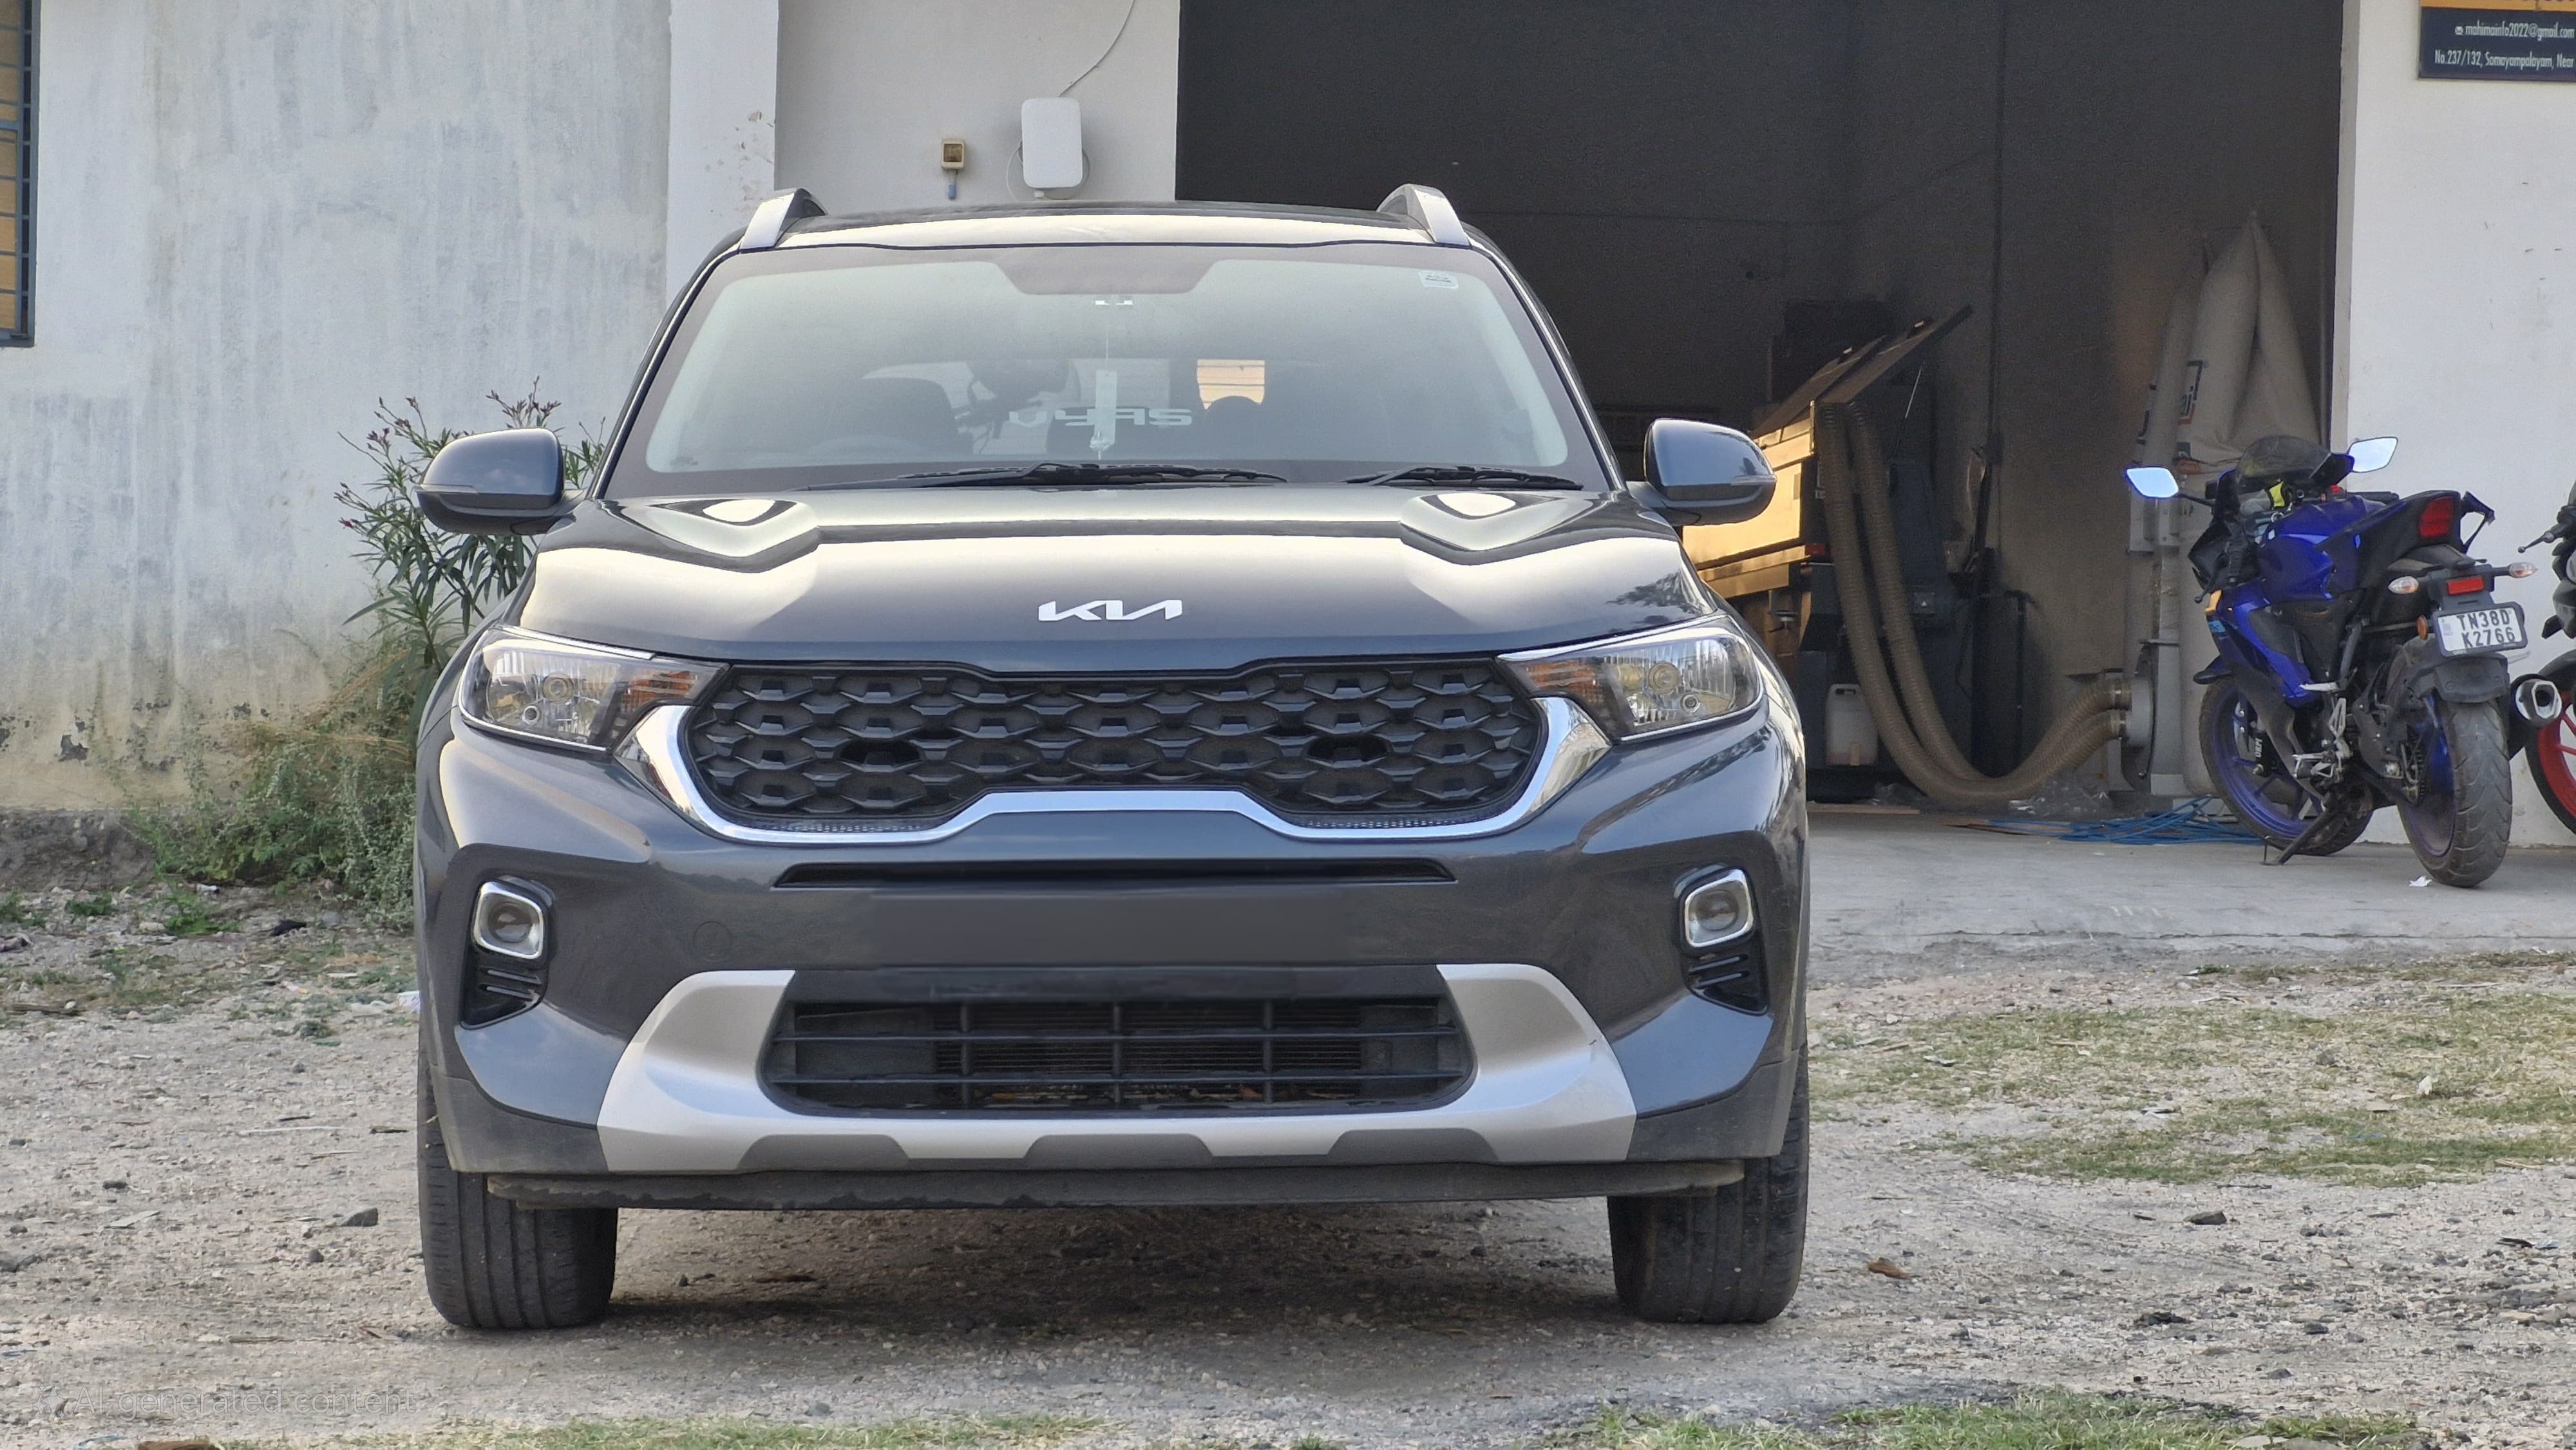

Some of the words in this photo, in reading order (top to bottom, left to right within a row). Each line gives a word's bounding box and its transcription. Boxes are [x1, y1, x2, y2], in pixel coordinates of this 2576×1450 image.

[2557, 53, 2575, 68] Near
[1039, 599, 1182, 621] KIA
[2456, 609, 2510, 630] TN38D
[2461, 627, 2515, 648] K2766
